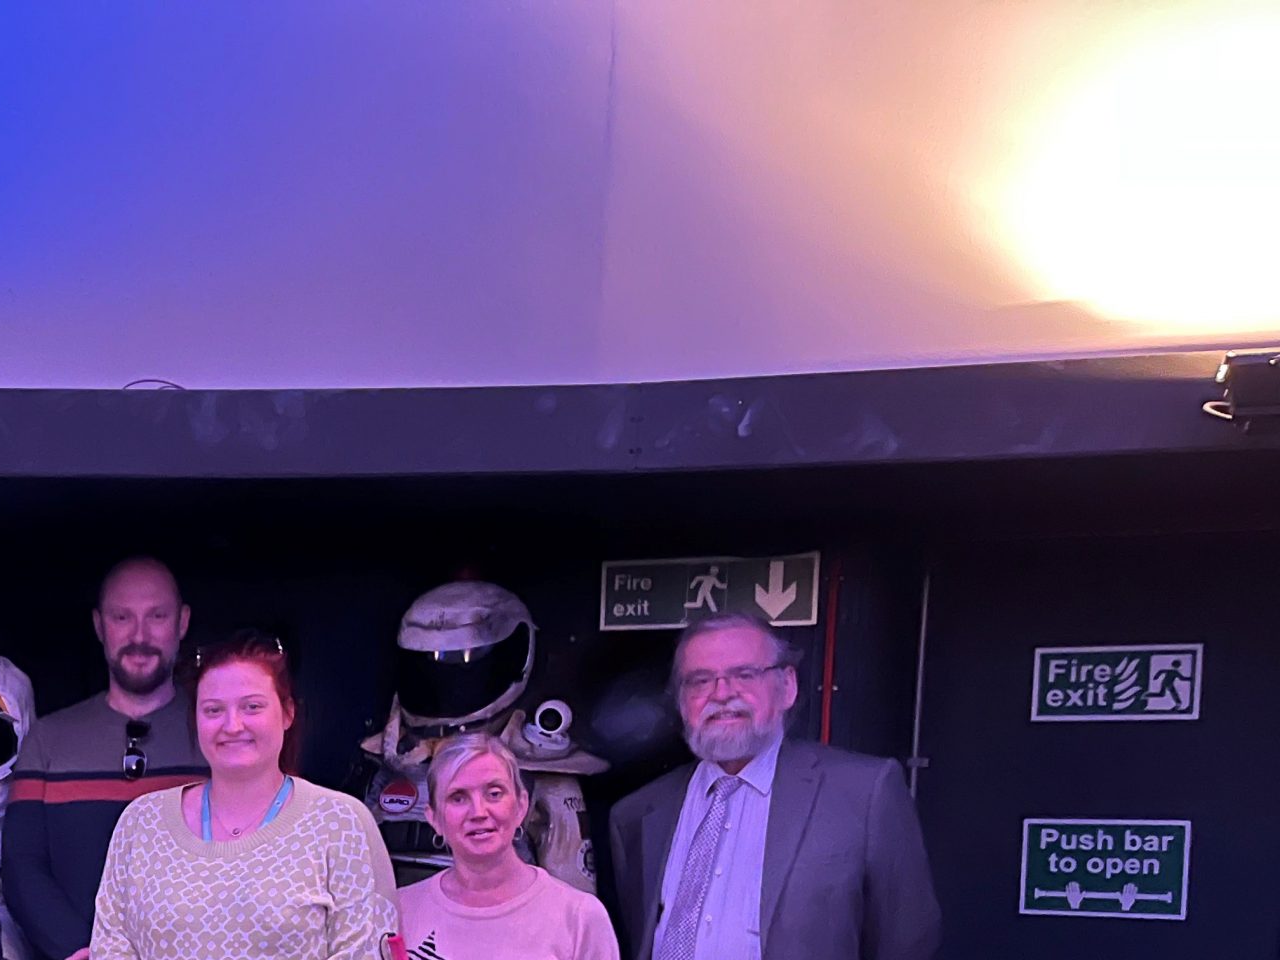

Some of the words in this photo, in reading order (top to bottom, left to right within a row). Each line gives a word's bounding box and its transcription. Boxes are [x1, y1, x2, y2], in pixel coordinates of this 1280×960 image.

[613, 574, 653, 592] Fire
[612, 599, 650, 617] exit
[1047, 658, 1112, 683] Fire
[1046, 685, 1108, 708] exit
[1040, 828, 1114, 851] Push
[1124, 830, 1175, 852] bar
[1048, 853, 1078, 873] to
[1086, 856, 1161, 879] open
